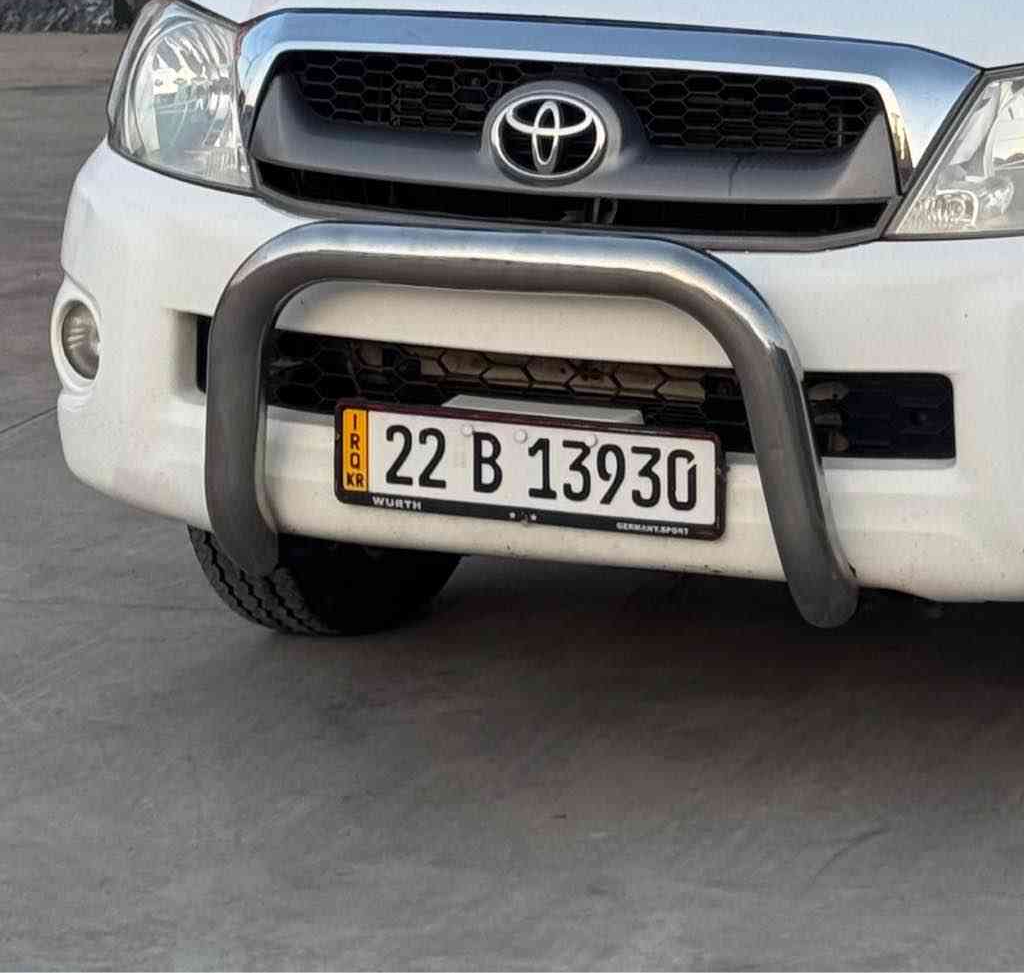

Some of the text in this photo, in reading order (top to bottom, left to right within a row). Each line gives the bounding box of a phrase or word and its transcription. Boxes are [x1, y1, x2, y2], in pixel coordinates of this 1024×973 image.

[386, 425, 697, 511] 22 B 13930
